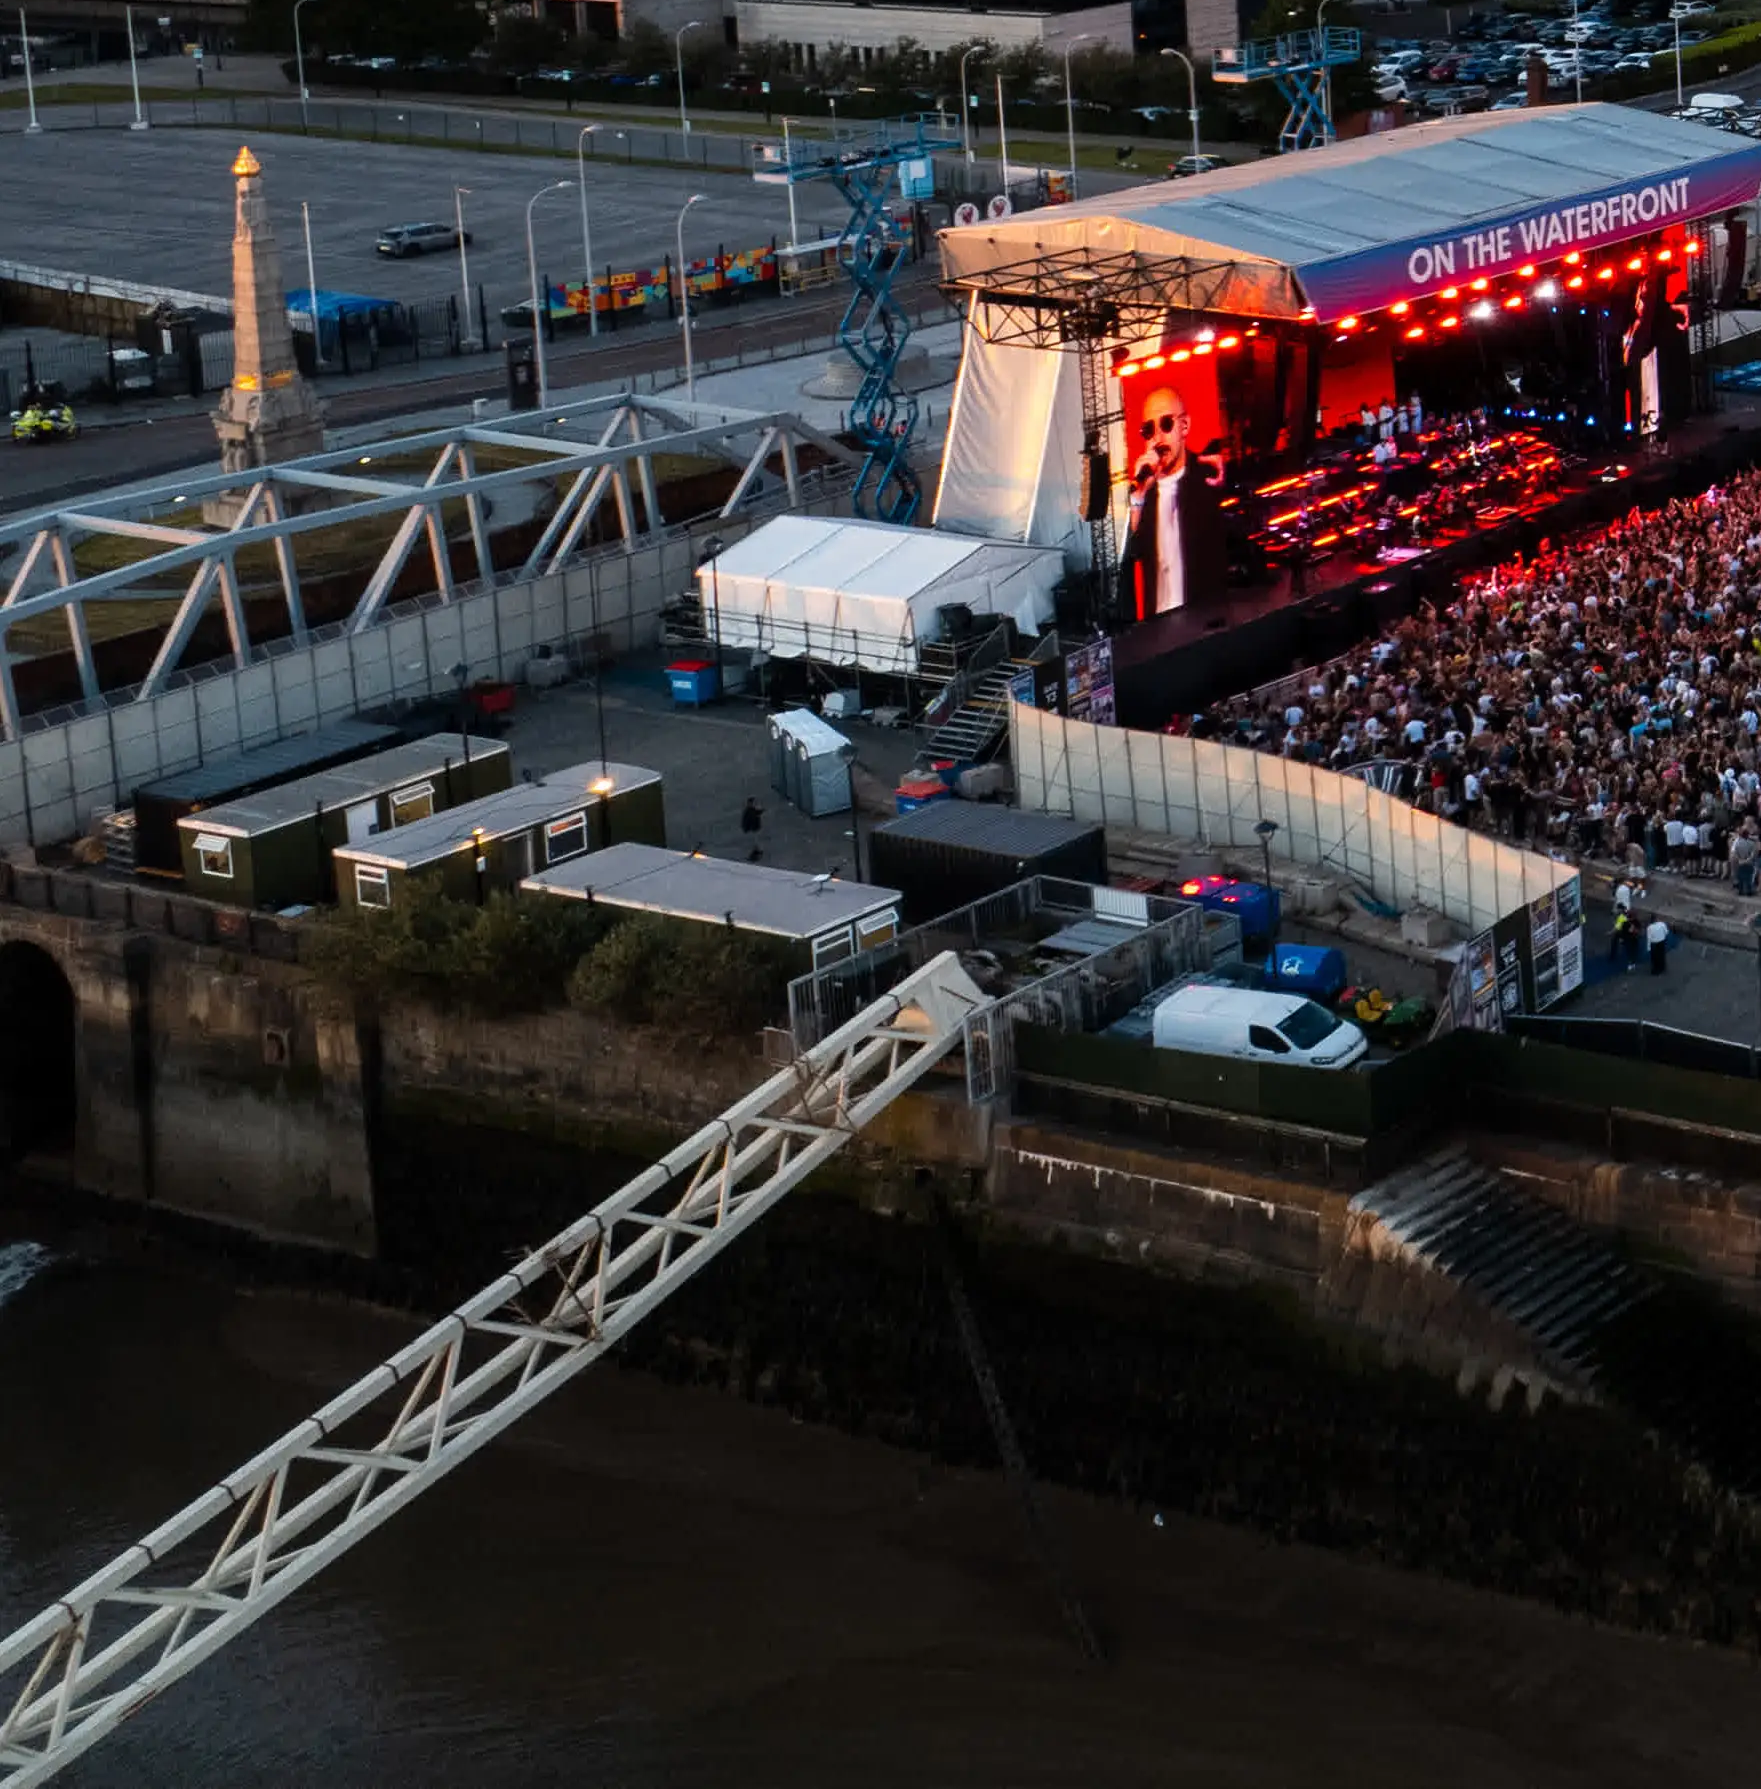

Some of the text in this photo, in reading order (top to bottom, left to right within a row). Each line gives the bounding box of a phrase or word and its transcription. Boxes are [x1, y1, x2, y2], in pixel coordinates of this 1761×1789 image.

[1408, 178, 1690, 283] ON THE WATERFRONT
